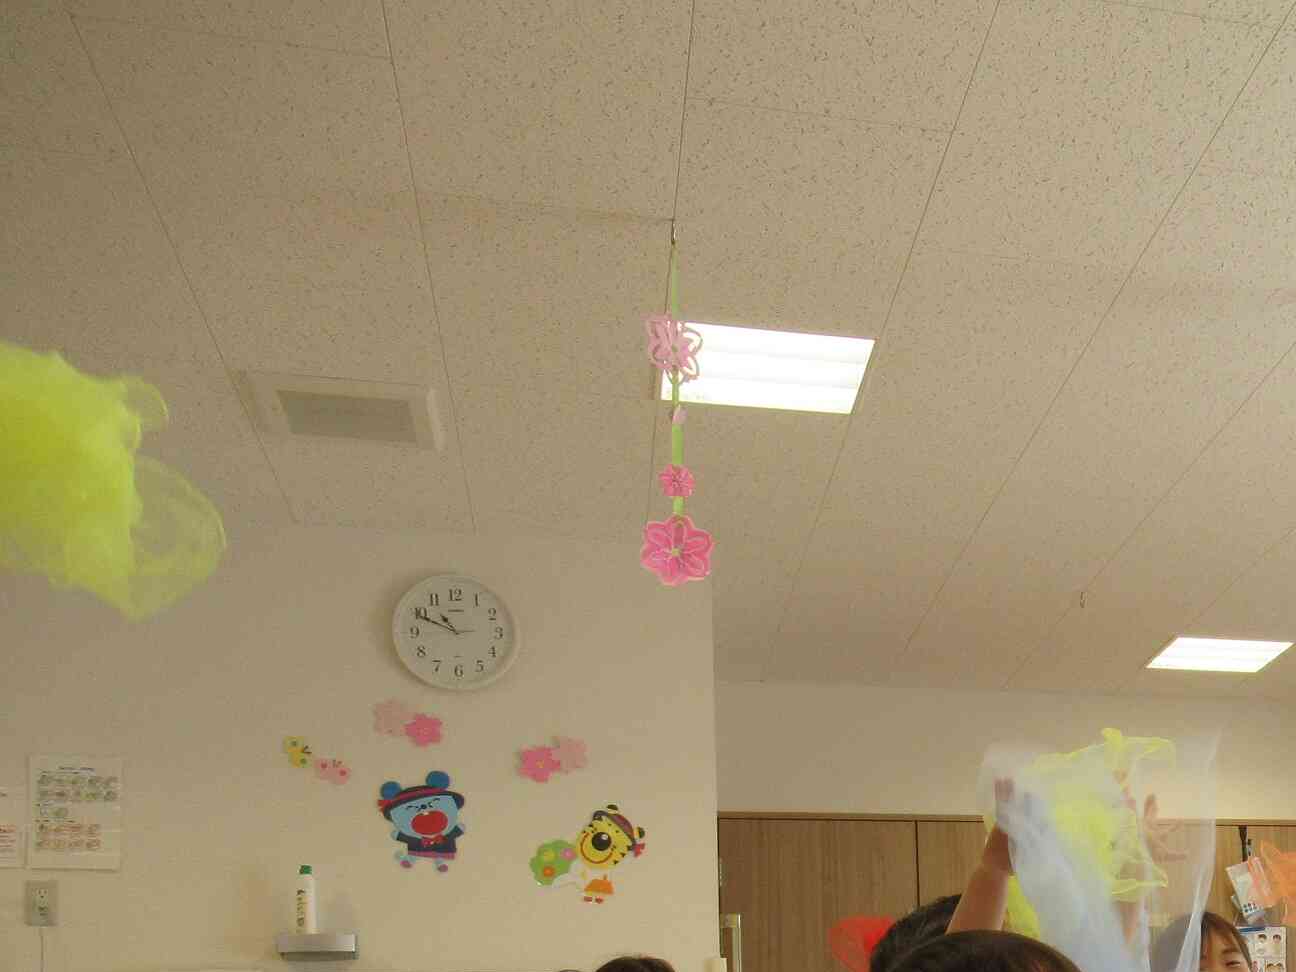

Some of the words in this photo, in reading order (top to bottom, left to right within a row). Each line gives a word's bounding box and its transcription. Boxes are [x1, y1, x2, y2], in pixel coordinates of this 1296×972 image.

[429, 593, 440, 606] 11
[447, 588, 462, 602] 12
[474, 593, 480, 607] 1
[414, 607, 428, 620] 10
[487, 607, 497, 621] 2
[409, 626, 420, 640] 9
[495, 626, 504, 640] 3
[416, 645, 426, 658] 8
[487, 645, 497, 658] 4
[432, 659, 442, 673] 7
[454, 664, 464, 678] 6
[475, 659, 484, 672] 5
